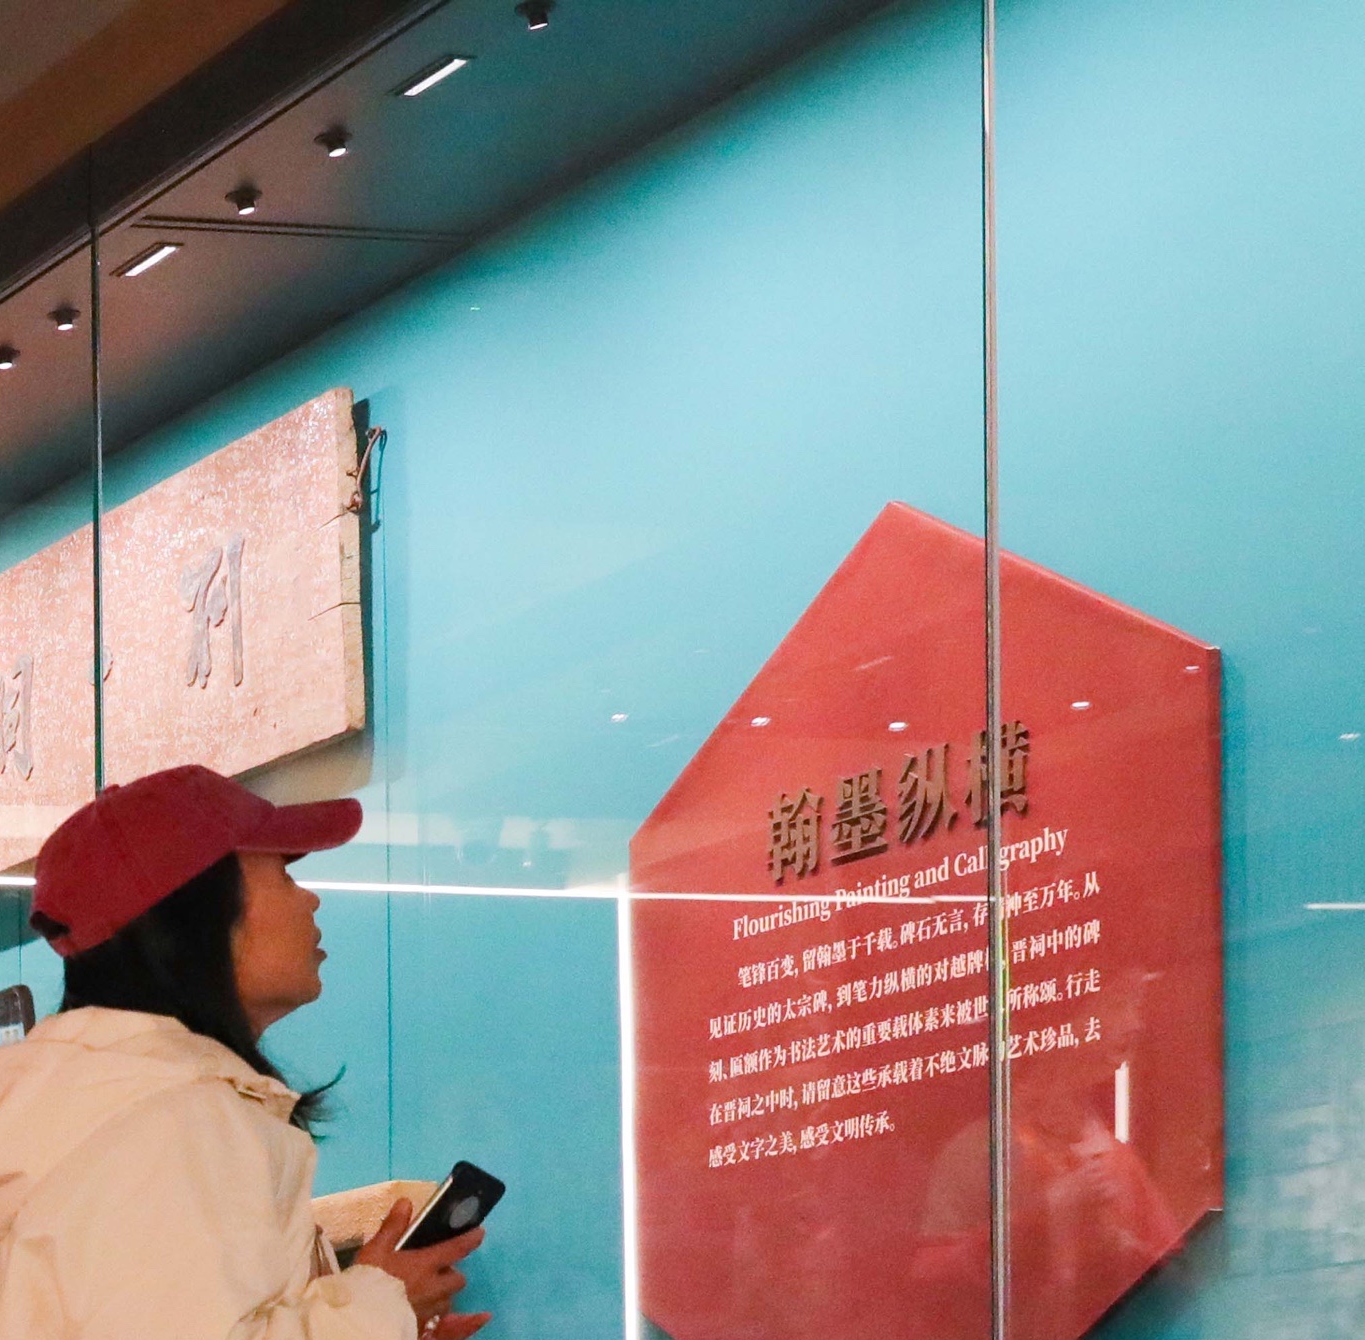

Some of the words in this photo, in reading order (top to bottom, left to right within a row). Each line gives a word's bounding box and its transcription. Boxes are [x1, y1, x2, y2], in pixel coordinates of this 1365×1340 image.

[768, 720, 1030, 886] 翰墨纵横
[733, 896, 832, 941] Flourishing
[835, 873, 911, 912] Painting
[914, 857, 950, 889] and
[954, 827, 1068, 877] Callgraphy
